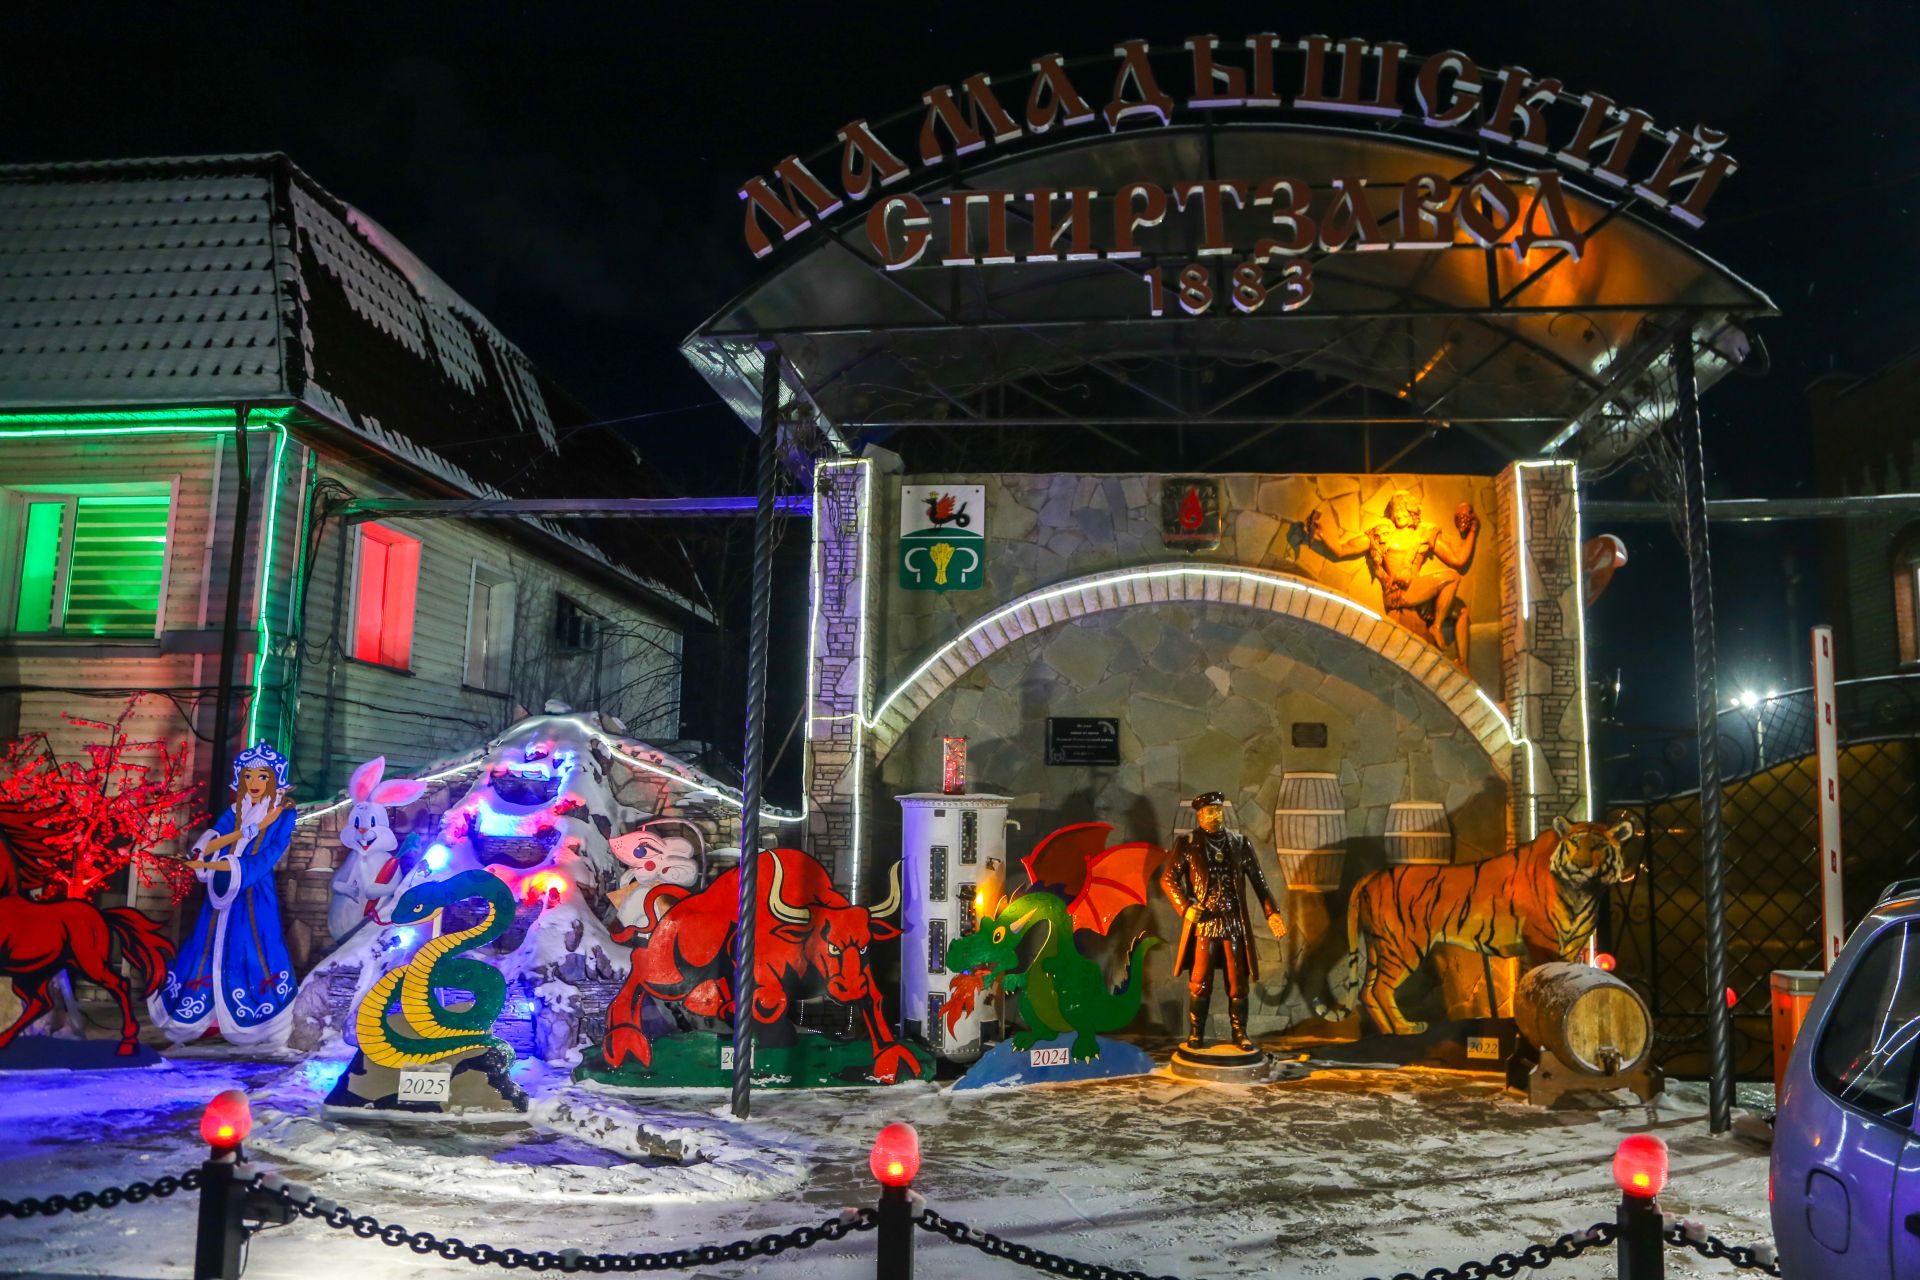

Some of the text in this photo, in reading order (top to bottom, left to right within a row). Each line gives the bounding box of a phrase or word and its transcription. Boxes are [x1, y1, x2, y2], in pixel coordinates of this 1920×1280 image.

[737, 32, 1739, 259] МАМАДЫШСКИЙ
[866, 168, 1587, 270] СПИРТЗАВОД
[1143, 260, 1314, 316] 1883
[1032, 1049, 1068, 1066] 2024
[1468, 1041, 1498, 1054] 2022
[402, 1078, 446, 1095] 2025
